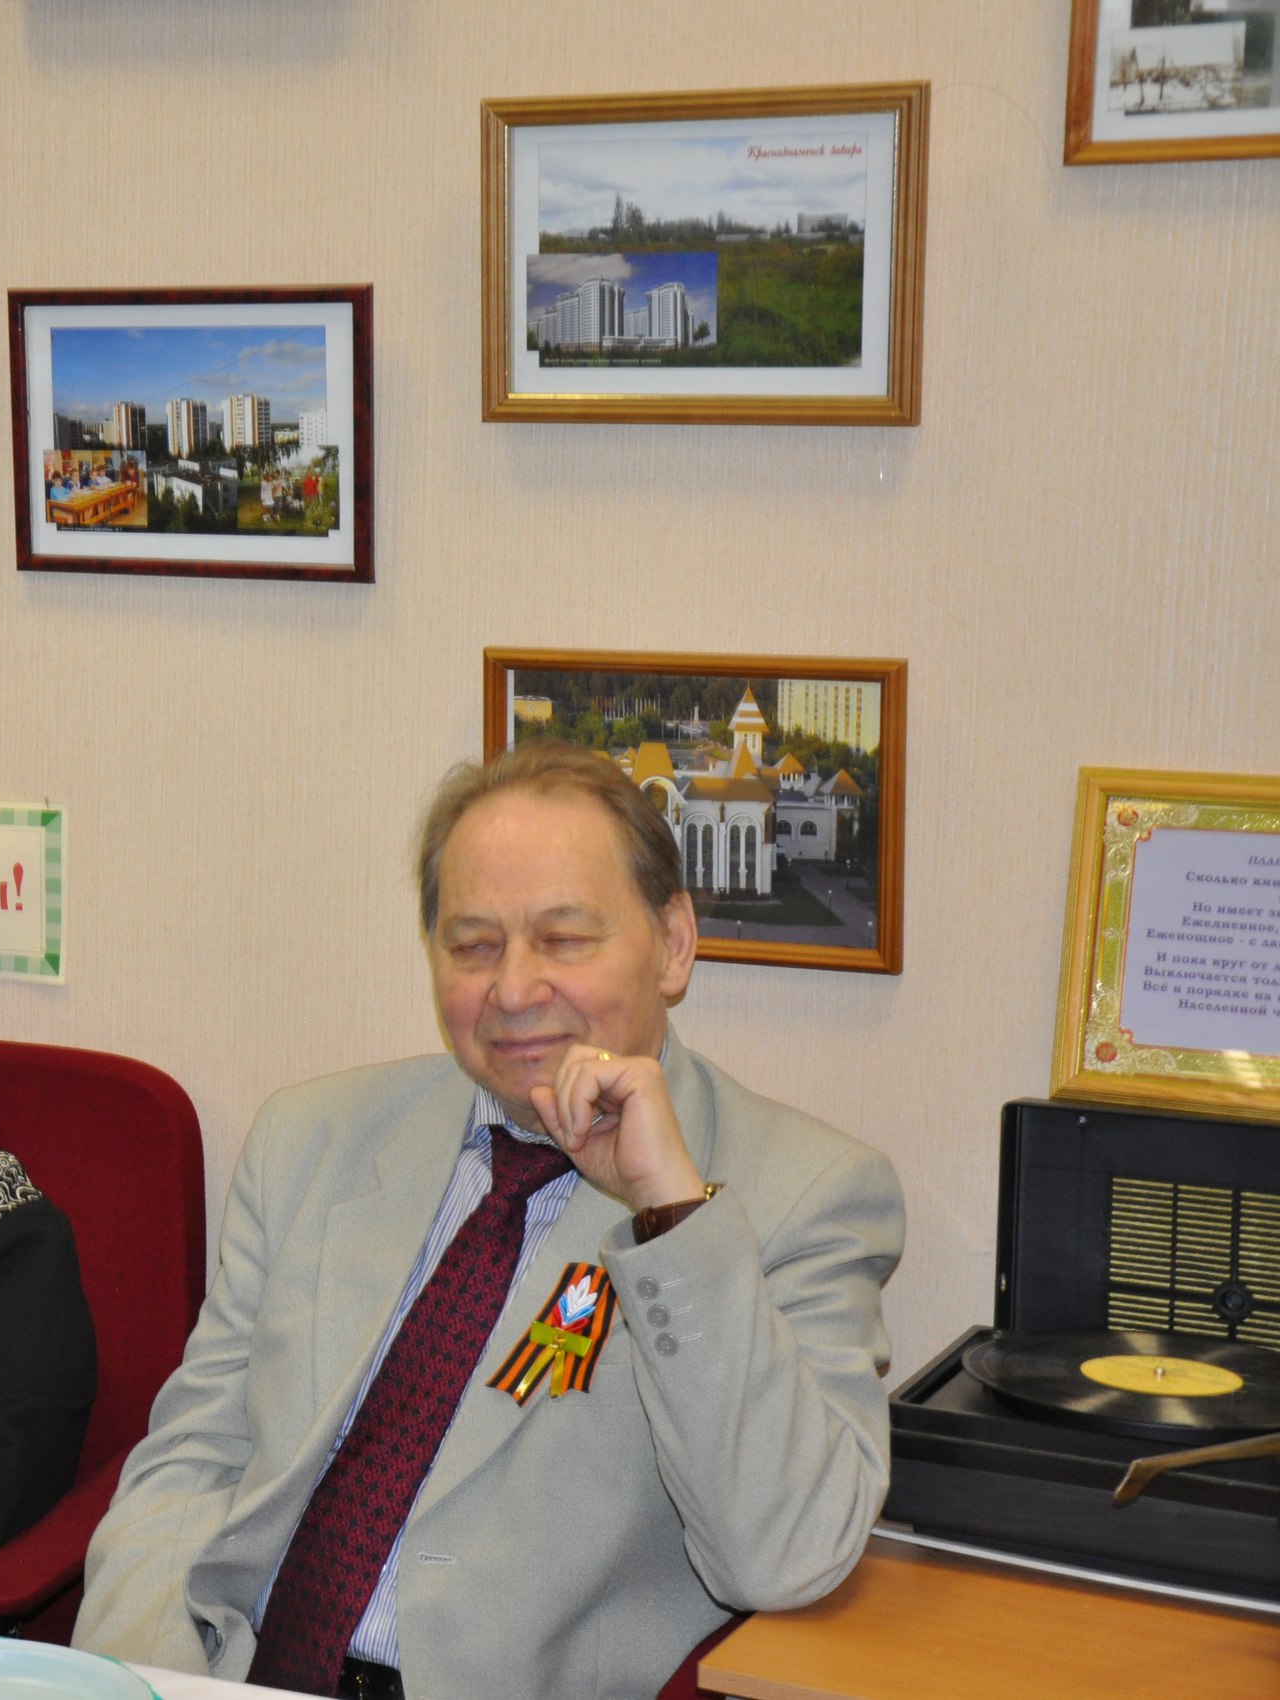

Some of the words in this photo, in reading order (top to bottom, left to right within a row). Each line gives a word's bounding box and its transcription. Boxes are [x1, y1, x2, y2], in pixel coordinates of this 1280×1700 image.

[1185, 871, 1248, 885] Сколько
[1192, 902, 1212, 913] Но
[1217, 906, 1263, 916] имеет
[1181, 916, 1279, 934] Ежедневное,
[1146, 928, 1234, 944] Еженощное
[1261, 939, 1280, 949] ла
[1156, 952, 1167, 962] И
[1172, 955, 1207, 965] пока
[1212, 958, 1247, 970] круг
[1251, 961, 1269, 970] от
[1144, 965, 1248, 984] Выключается
[1252, 977, 1280, 987] тол
[1142, 981, 1168, 992] Всё
[1187, 986, 1249, 999] порядке
[1254, 992, 1271, 1001] на
[1178, 999, 1267, 1016] Населенной
